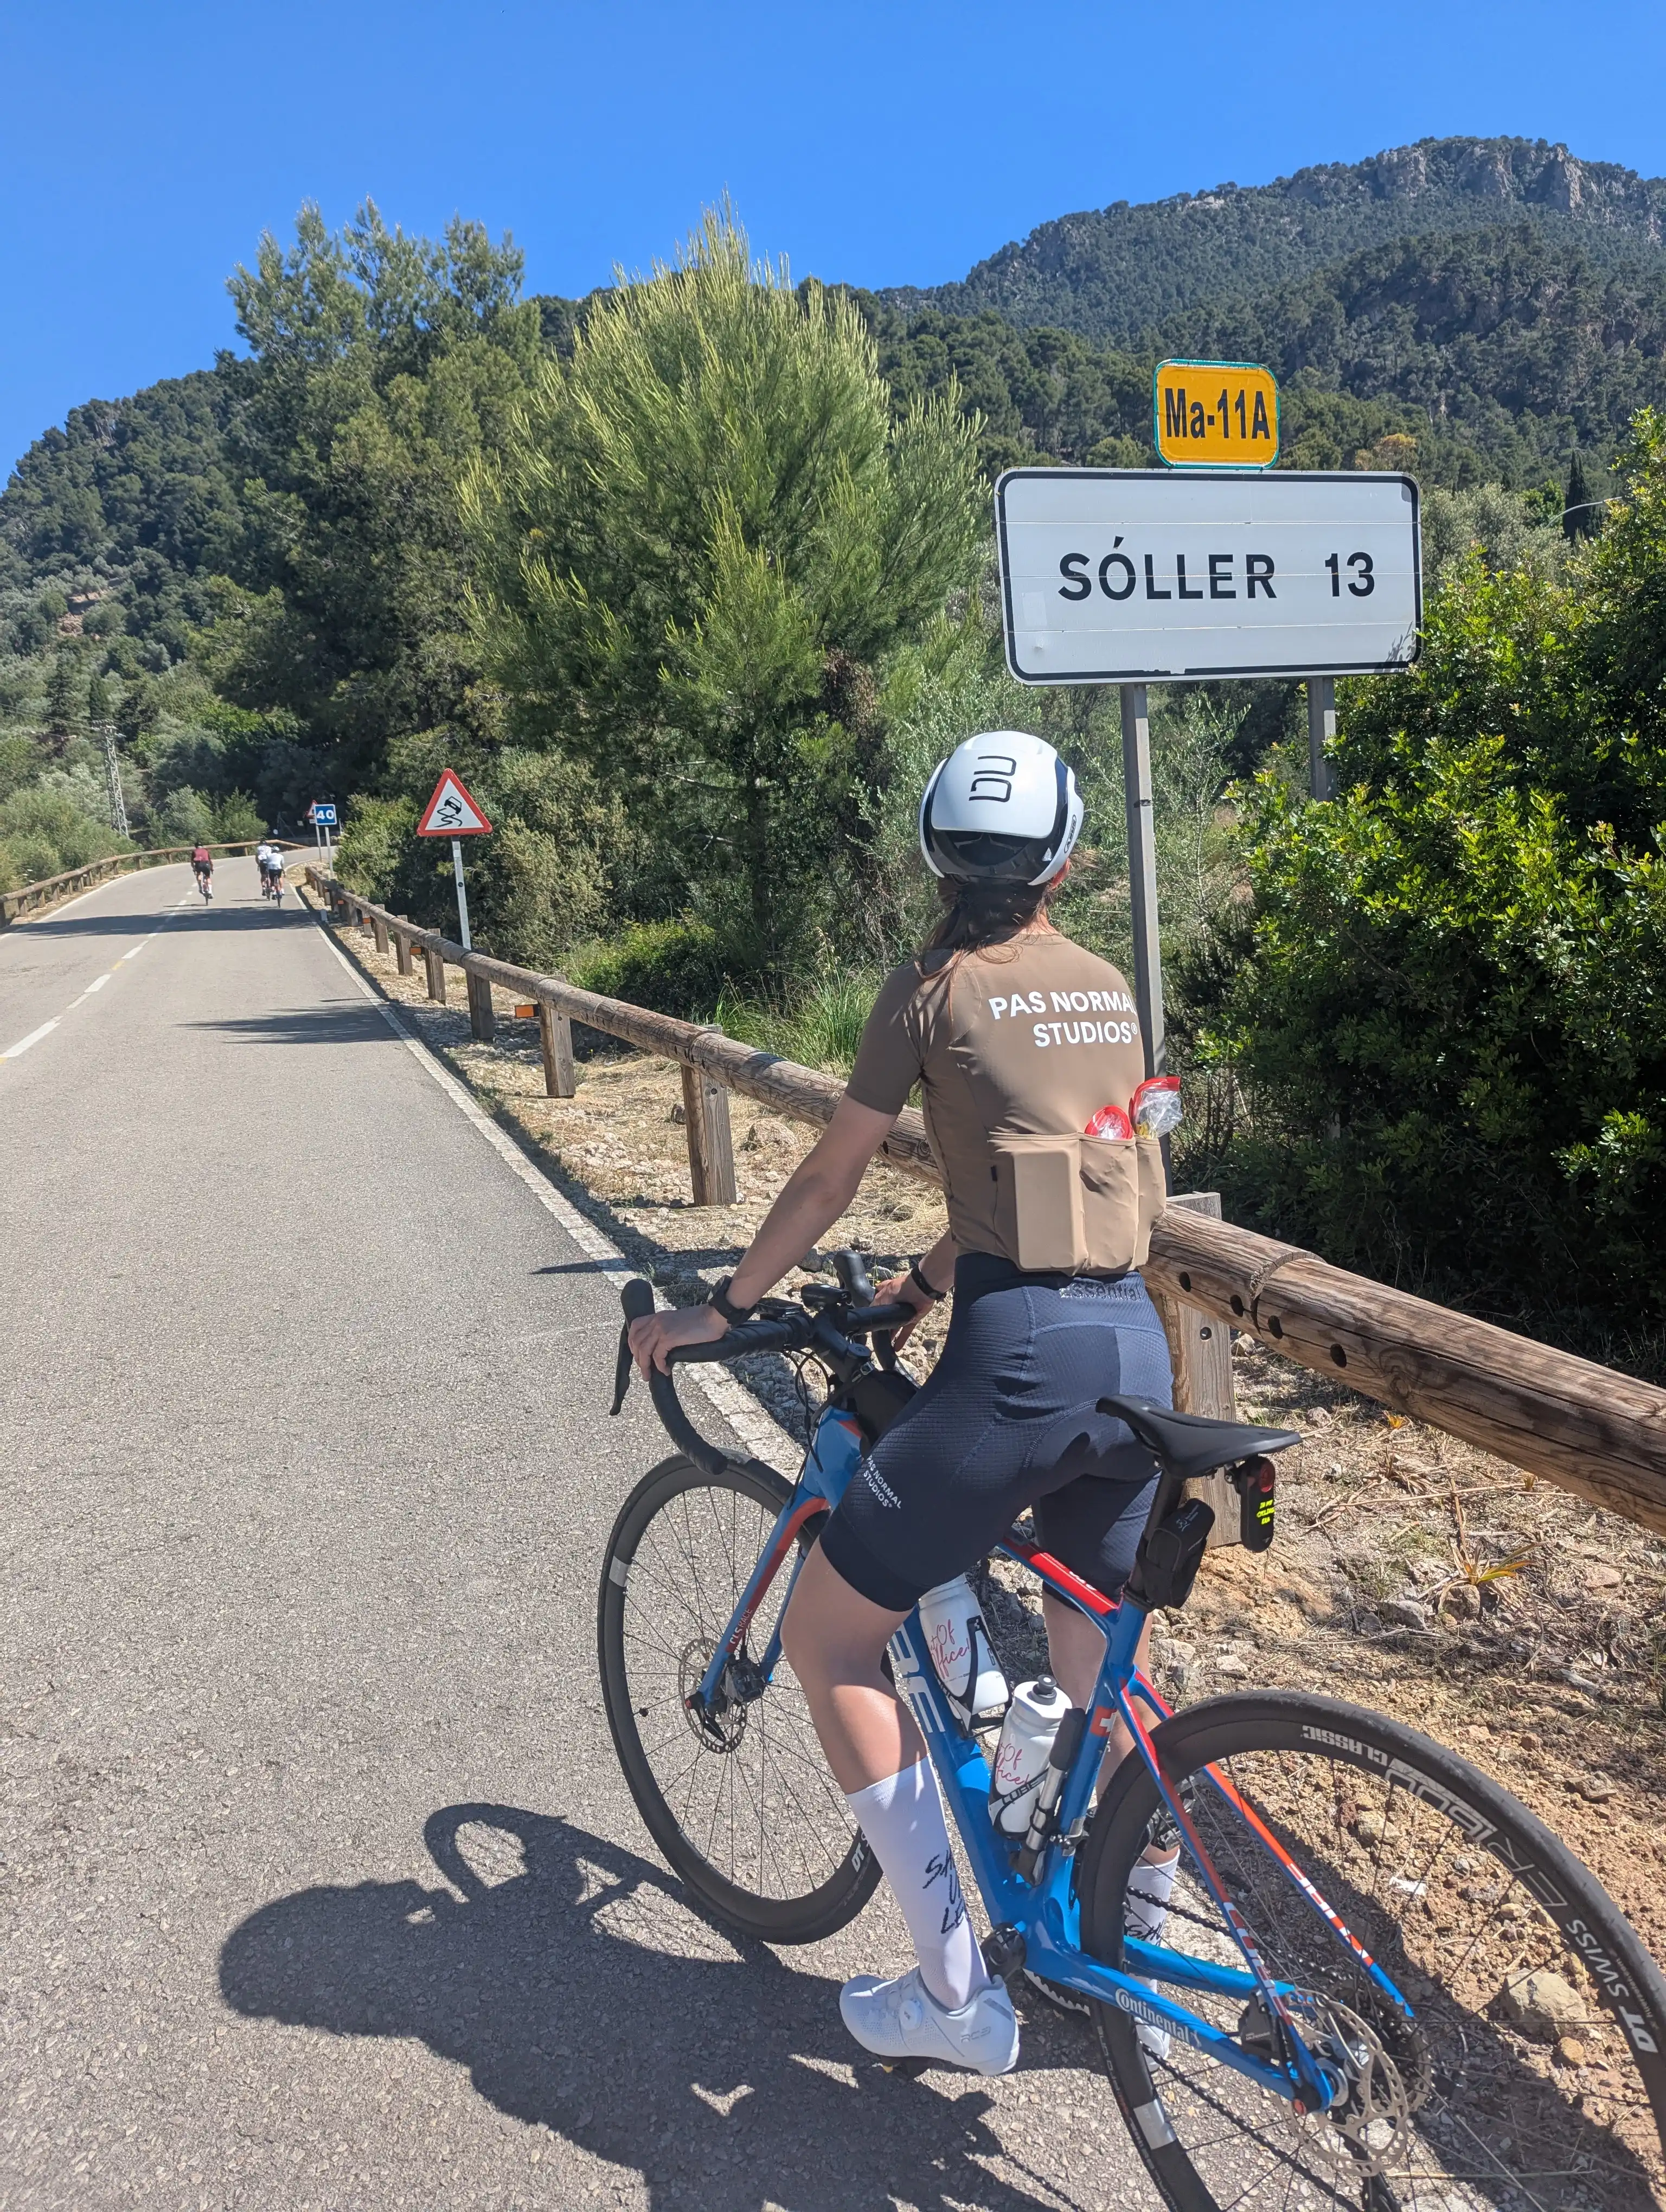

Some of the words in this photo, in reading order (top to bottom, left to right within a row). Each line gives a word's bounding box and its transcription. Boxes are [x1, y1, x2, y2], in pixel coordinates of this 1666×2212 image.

[1164, 388, 1271, 440] Ma-11A
[1058, 536, 1277, 601] SÓLLER
[1324, 551, 1375, 597] 13
[316, 809, 335, 820] 40
[988, 991, 1047, 1020] PAS
[867, 1455, 876, 1471] PAS
[873, 1470, 901, 1509] NORMAL
[738, 1609, 753, 1628] RACE
[891, 1622, 946, 1733] BE
[851, 1842, 865, 1873] DT
[922, 1849, 956, 1889] SH
[940, 1898, 965, 1934] LE
[1566, 1919, 1630, 1997] SWISS
[1115, 1988, 1191, 2044] Continental
[1618, 2005, 1659, 2059] DT
